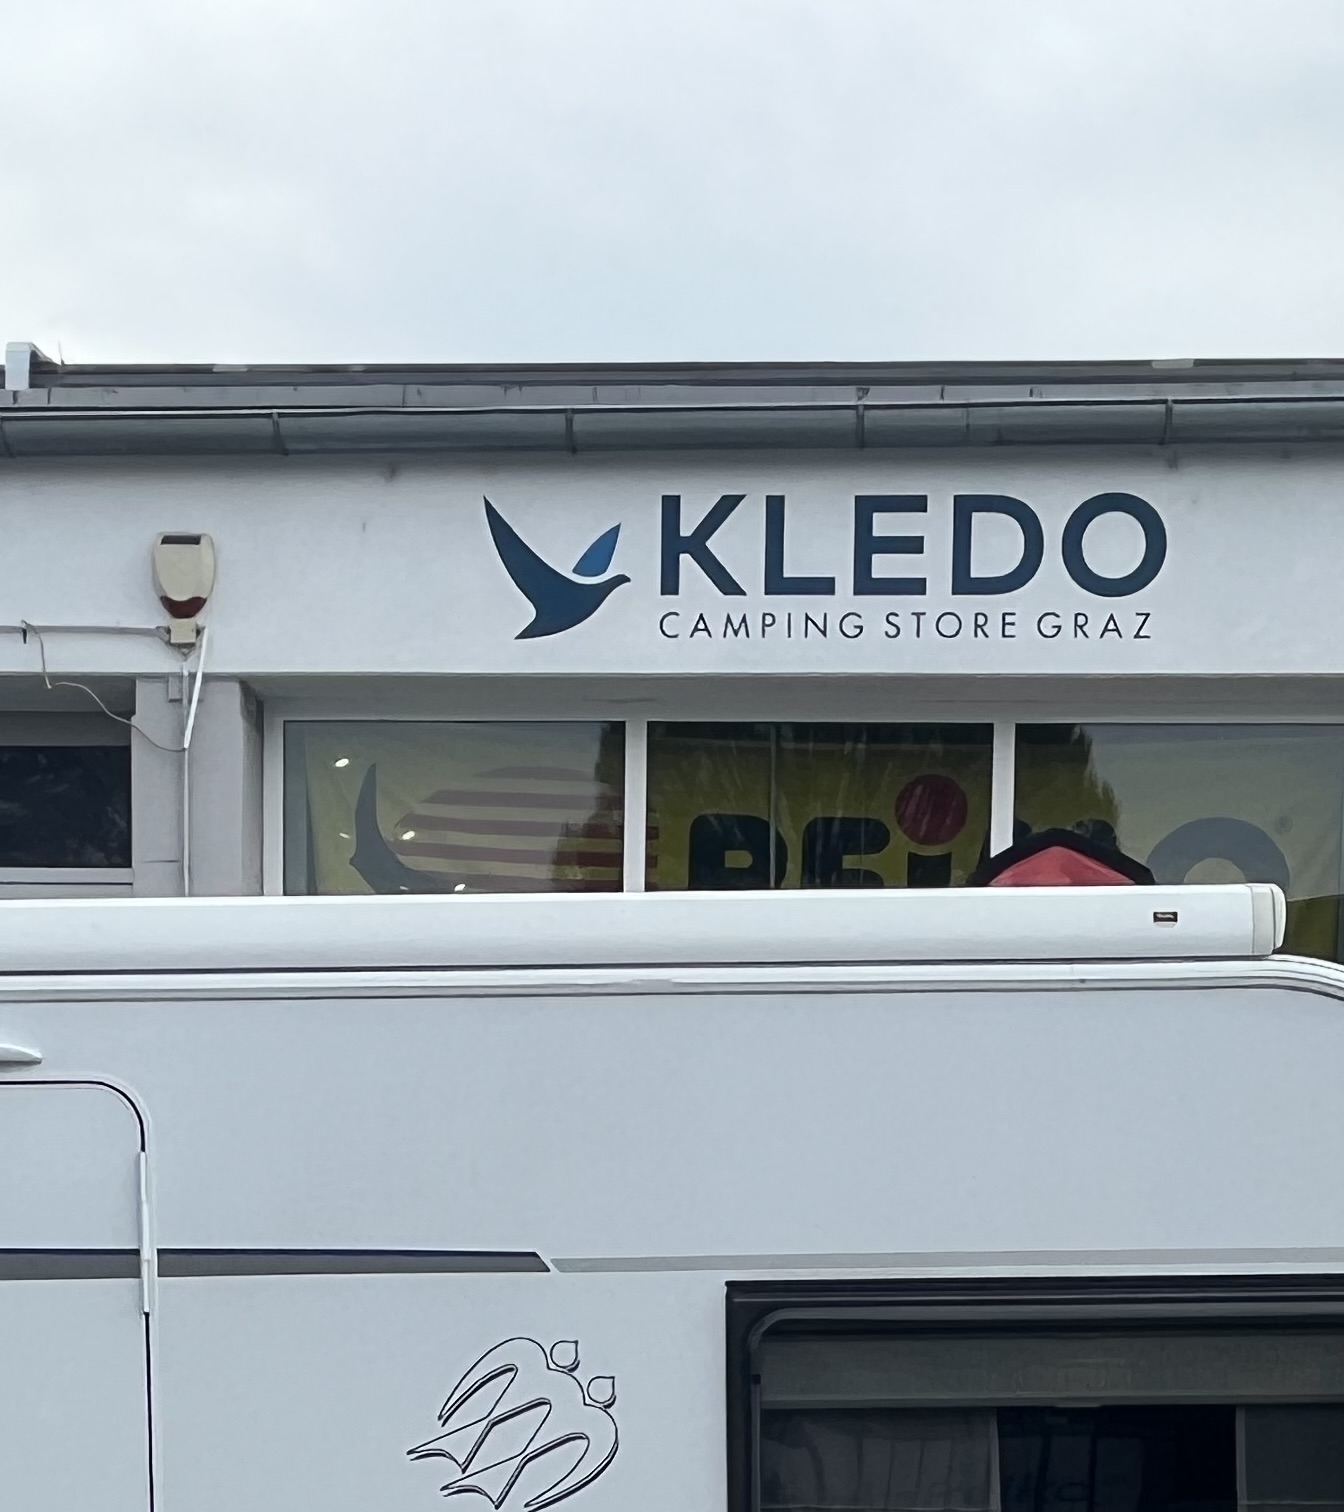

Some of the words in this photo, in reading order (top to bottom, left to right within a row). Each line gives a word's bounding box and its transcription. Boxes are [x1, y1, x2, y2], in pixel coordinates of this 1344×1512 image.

[660, 491, 1168, 598] KLEDO
[658, 611, 866, 641] CAMPING
[884, 611, 1018, 641] STORE
[1036, 611, 1152, 641] GRAZ
